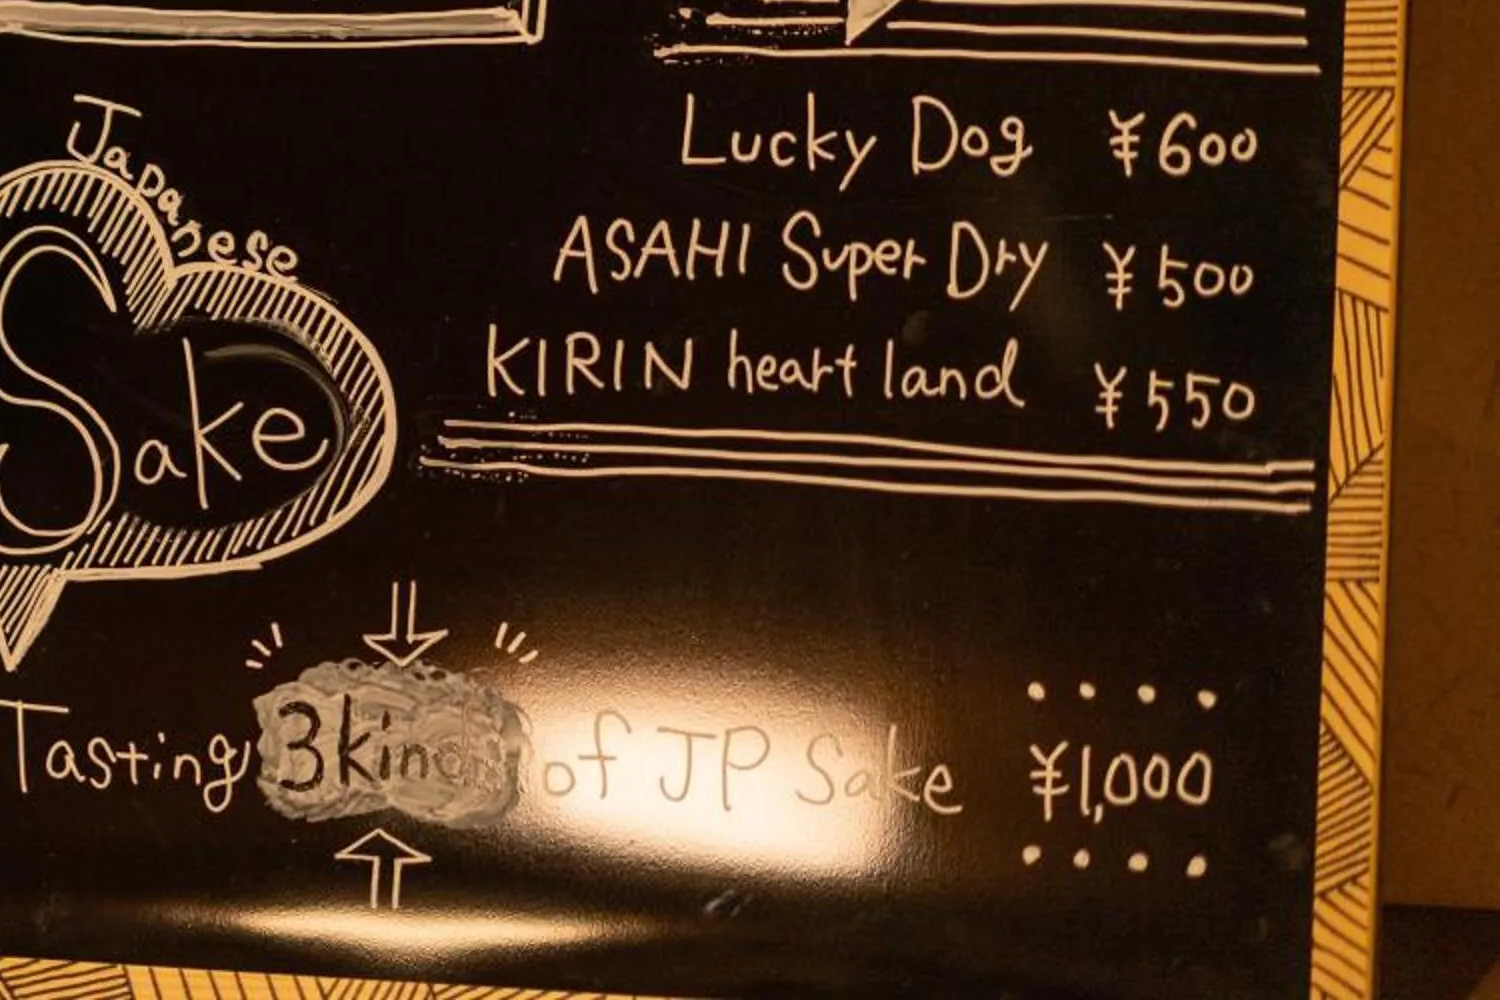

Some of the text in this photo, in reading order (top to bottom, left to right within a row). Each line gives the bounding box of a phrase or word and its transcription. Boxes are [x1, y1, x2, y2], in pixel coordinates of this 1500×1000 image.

[66, 94, 300, 282] Japanese
[681, 91, 1258, 192] Lucky Dog ¥600
[553, 210, 1254, 312] ASAHI Super Dry ¥500
[487, 323, 693, 398] KIRIN
[1094, 362, 1255, 431] ¥550
[544, 710, 631, 798] of
[658, 726, 772, 812] JP
[795, 724, 963, 815] Sake
[1029, 740, 1213, 824] ¥1,000
